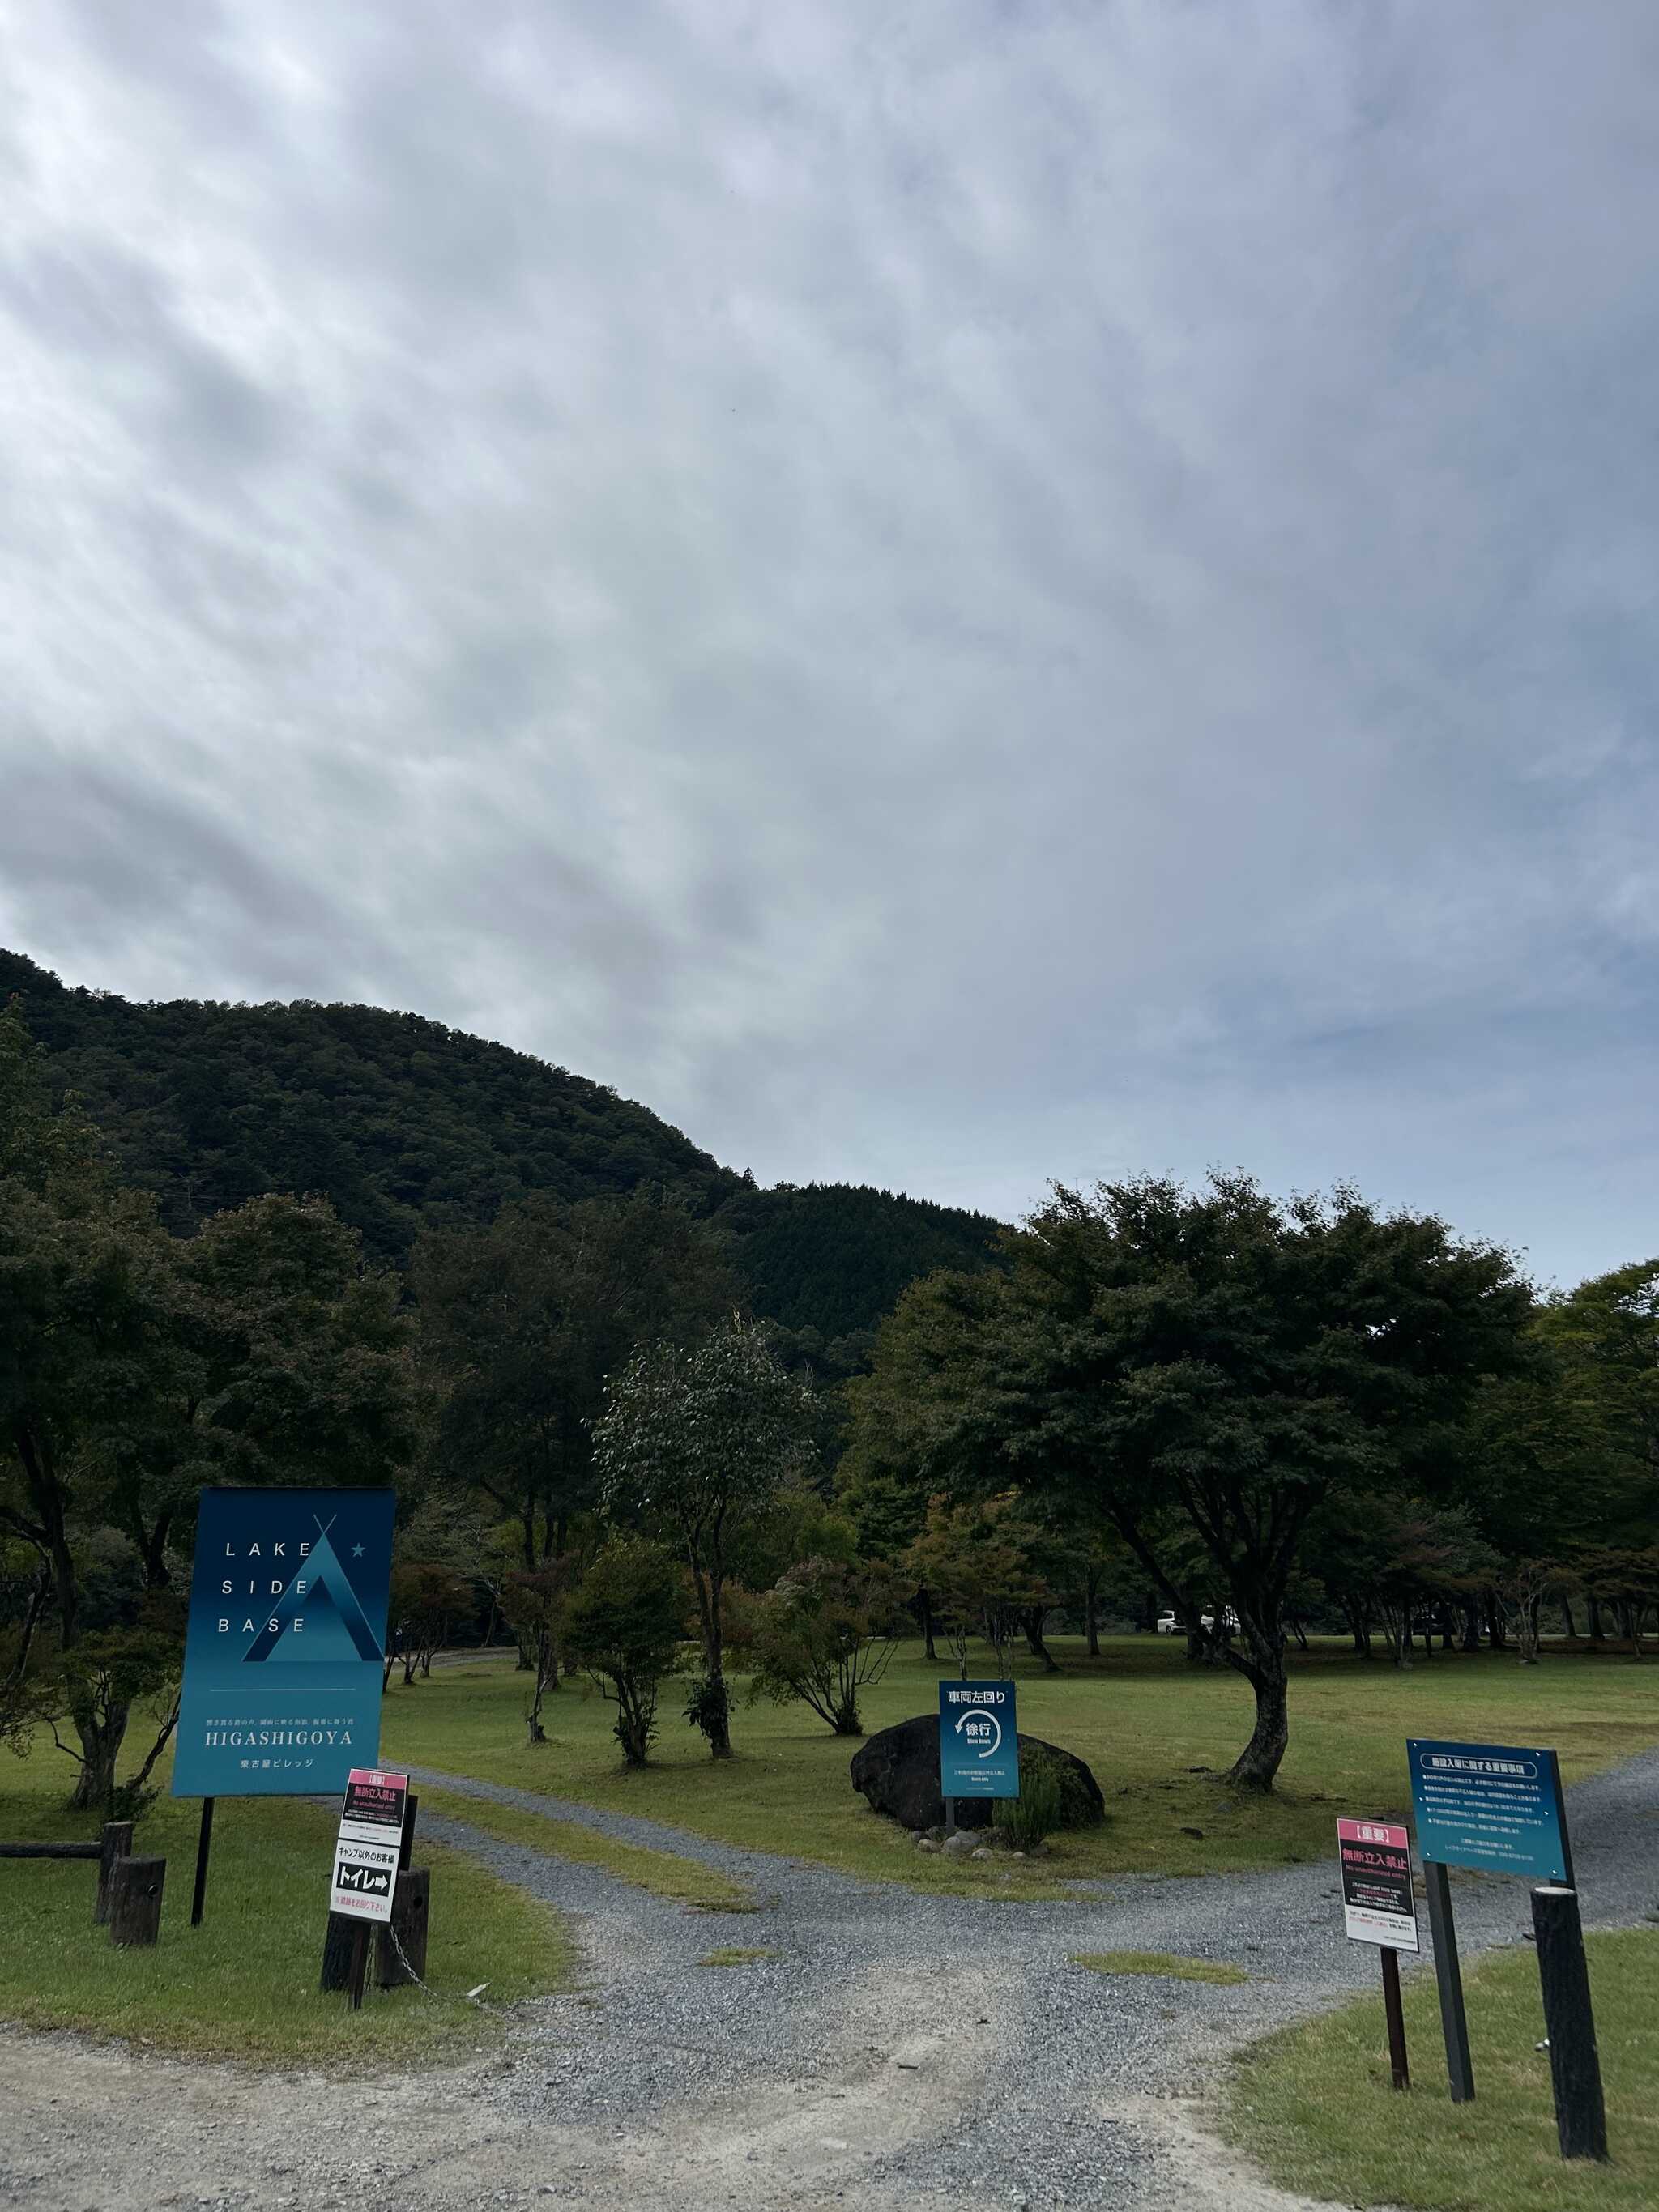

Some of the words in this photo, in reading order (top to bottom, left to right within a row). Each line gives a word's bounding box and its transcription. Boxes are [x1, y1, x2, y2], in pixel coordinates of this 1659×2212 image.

[226, 1542, 309, 1556] LAKE
[222, 1580, 307, 1594] SIDE
[218, 1618, 304, 1632] BASE
[948, 1690, 1005, 1704] 車両左回り
[966, 1723, 992, 1737] 徐行
[205, 1730, 352, 1746] HIGASHIGOYA
[240, 1758, 314, 1769] 東古屋ビレッジ
[353, 1786, 396, 1802] 無断立入禁止
[339, 1847, 394, 1864] キャンプ以外のお客様
[1341, 1848, 1408, 1871] 無断立入禁止
[340, 1865, 375, 1890] トイレ
